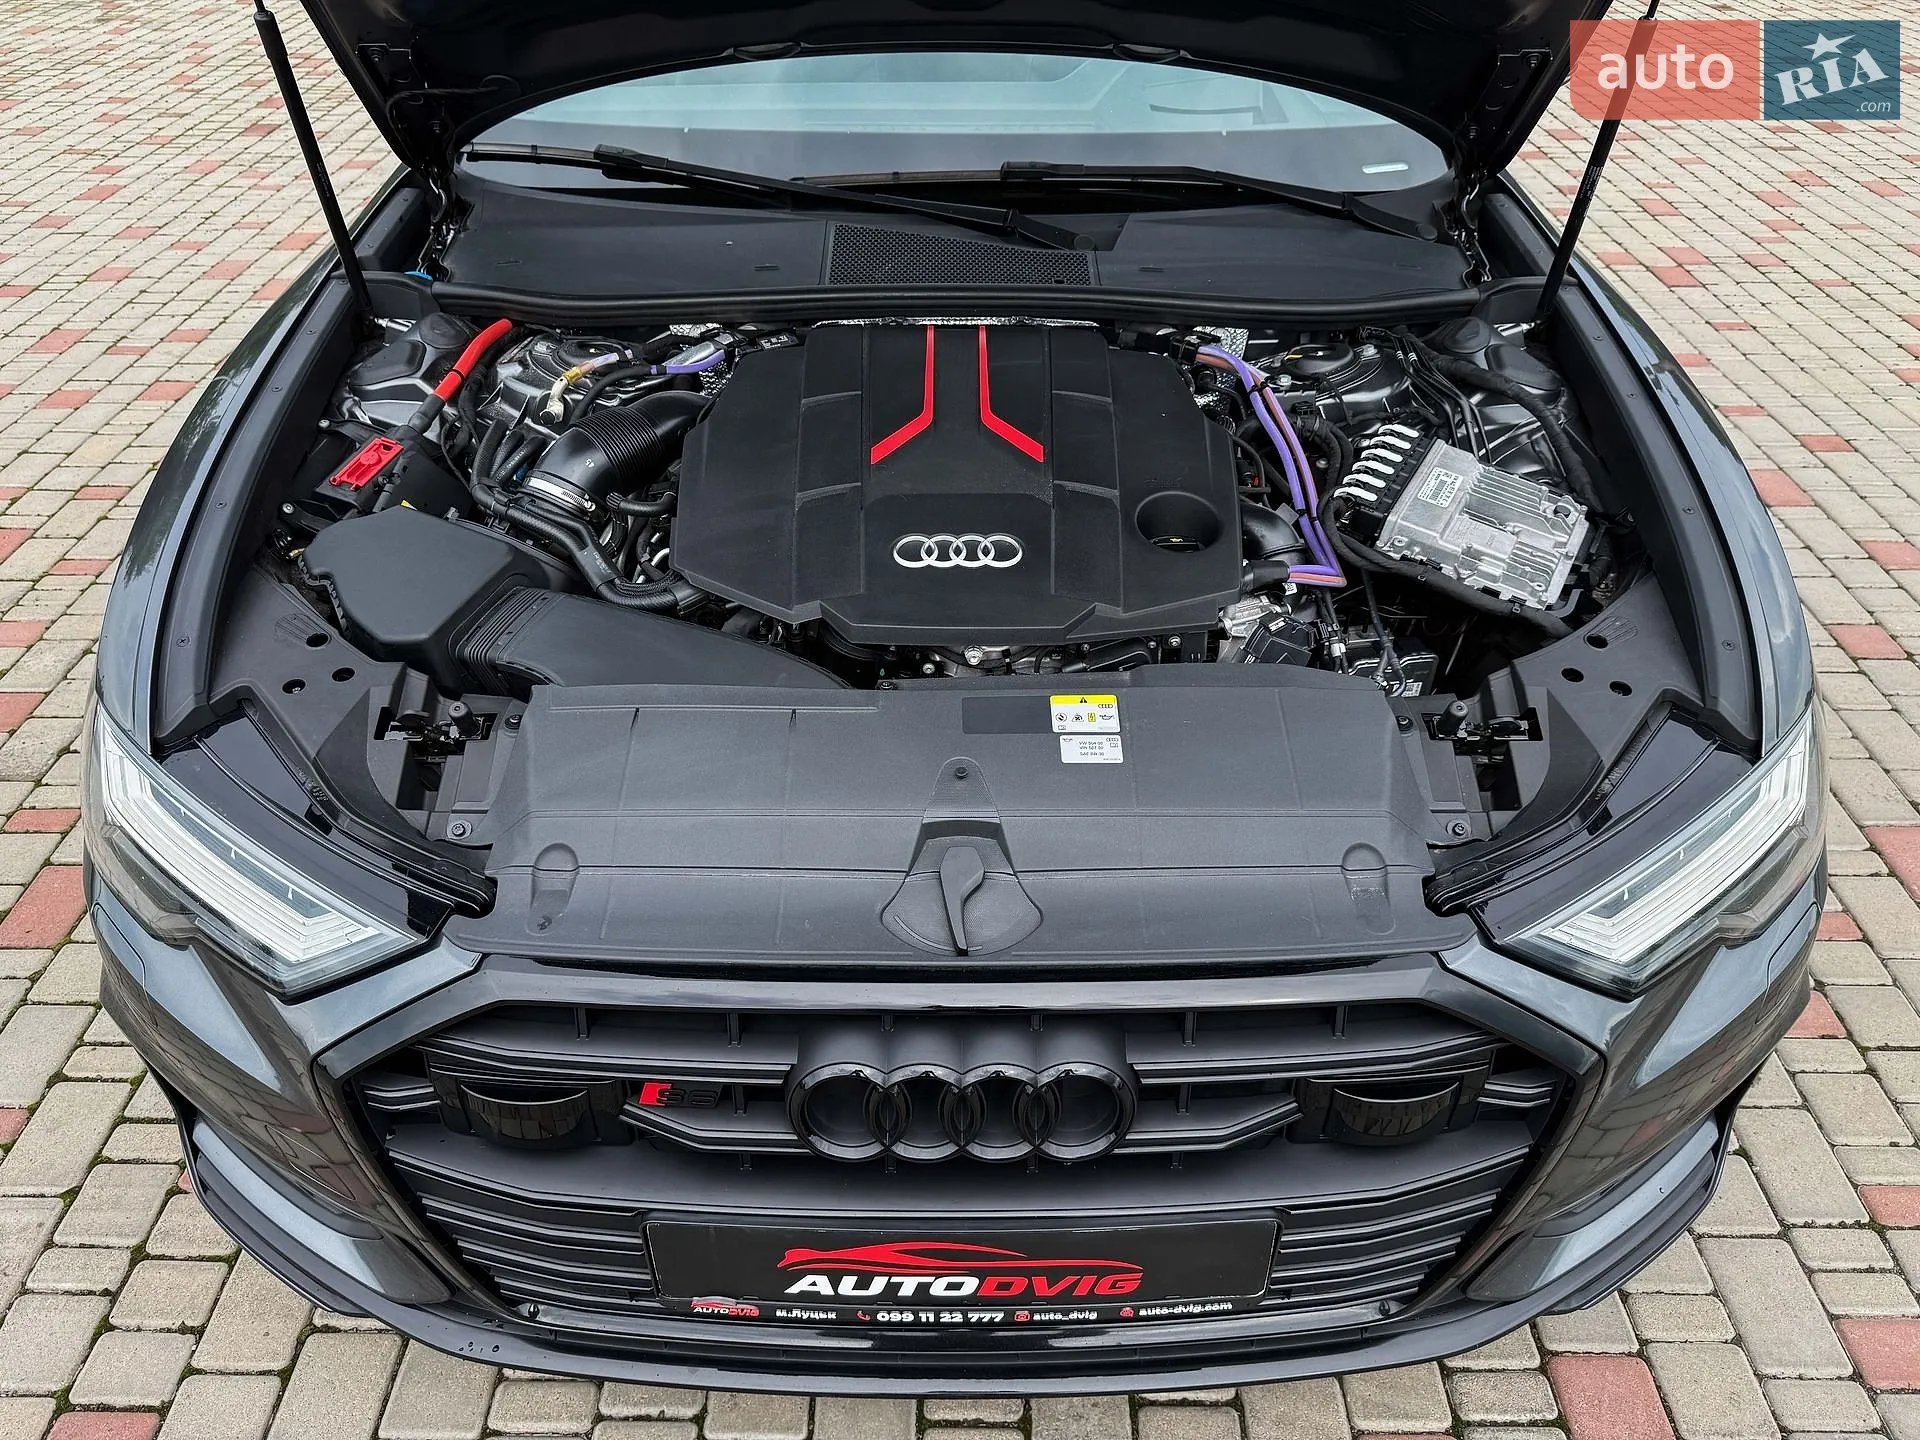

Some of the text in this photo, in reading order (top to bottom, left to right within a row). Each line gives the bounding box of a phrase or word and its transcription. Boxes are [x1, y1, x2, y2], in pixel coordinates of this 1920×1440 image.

[784, 1272, 1144, 1297] AUTODVIG
[1138, 1302, 1233, 1316] auto-dvig.com
[876, 1311, 1005, 1322] 099 11 22 777
[1033, 1310, 1098, 1321] auto_dvig
